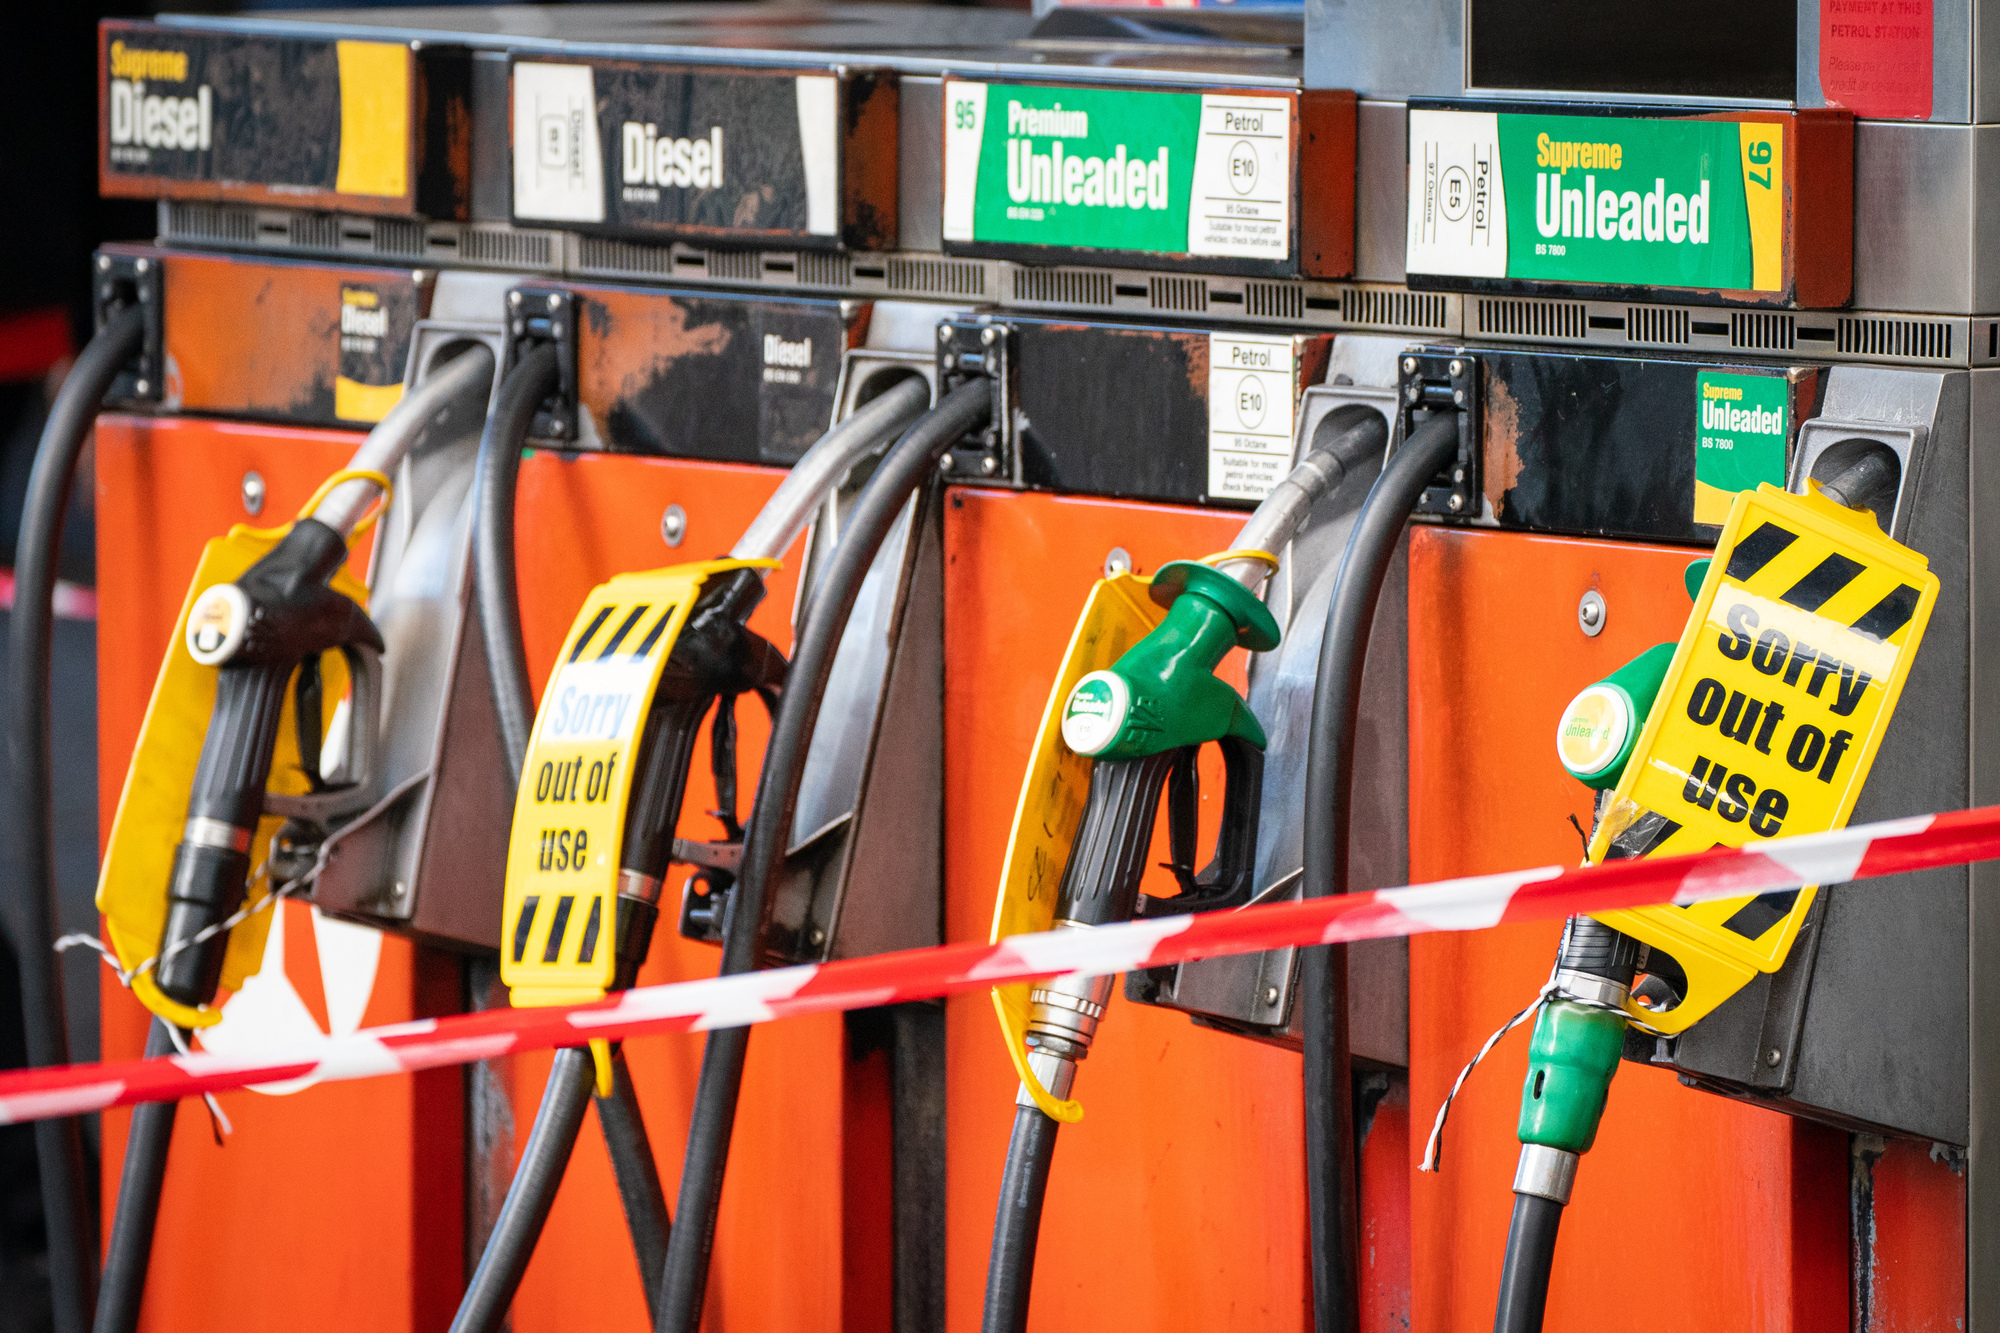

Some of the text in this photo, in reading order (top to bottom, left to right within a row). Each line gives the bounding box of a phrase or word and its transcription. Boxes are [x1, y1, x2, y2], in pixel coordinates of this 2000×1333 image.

[1829, 0, 1922, 15] PAYMENT AT THIS
[1831, 24, 1920, 39] PETROL STATION
[111, 40, 188, 84] Supreme
[1828, 56, 1861, 71] Please
[111, 79, 211, 151] Diesel
[955, 100, 976, 129] 95
[1008, 100, 1088, 138] Premium
[1225, 112, 1264, 131] Petrol
[571, 109, 583, 178] Diesel
[623, 122, 723, 188] Diesel
[1536, 132, 1622, 175] Supreme
[1007, 138, 1169, 210] Unleaded
[1233, 159, 1254, 177] E10
[1748, 141, 1772, 190] 97
[1236, 204, 1259, 215] Octane
[1427, 162, 1435, 223] 97 Octane
[1449, 179, 1461, 208] E5
[1475, 160, 1488, 229] Petrol
[1536, 172, 1710, 245] Unleaded
[1535, 243, 1566, 256] BS 7800
[764, 333, 812, 367] Diesel
[1232, 346, 1271, 366] Petrol
[1240, 393, 1262, 411] E10
[1703, 382, 1743, 402] Supreme
[1702, 399, 1782, 435] Unleaded
[1244, 439, 1267, 449] Octane
[1702, 437, 1733, 450] BS 7800
[1717, 603, 1873, 717] Sorry
[553, 686, 632, 740] Sorry
[1686, 677, 1854, 784] out of
[1565, 724, 1610, 740] Unleadd
[536, 752, 618, 803] out of
[1682, 754, 1790, 838] use
[539, 829, 588, 872] use
